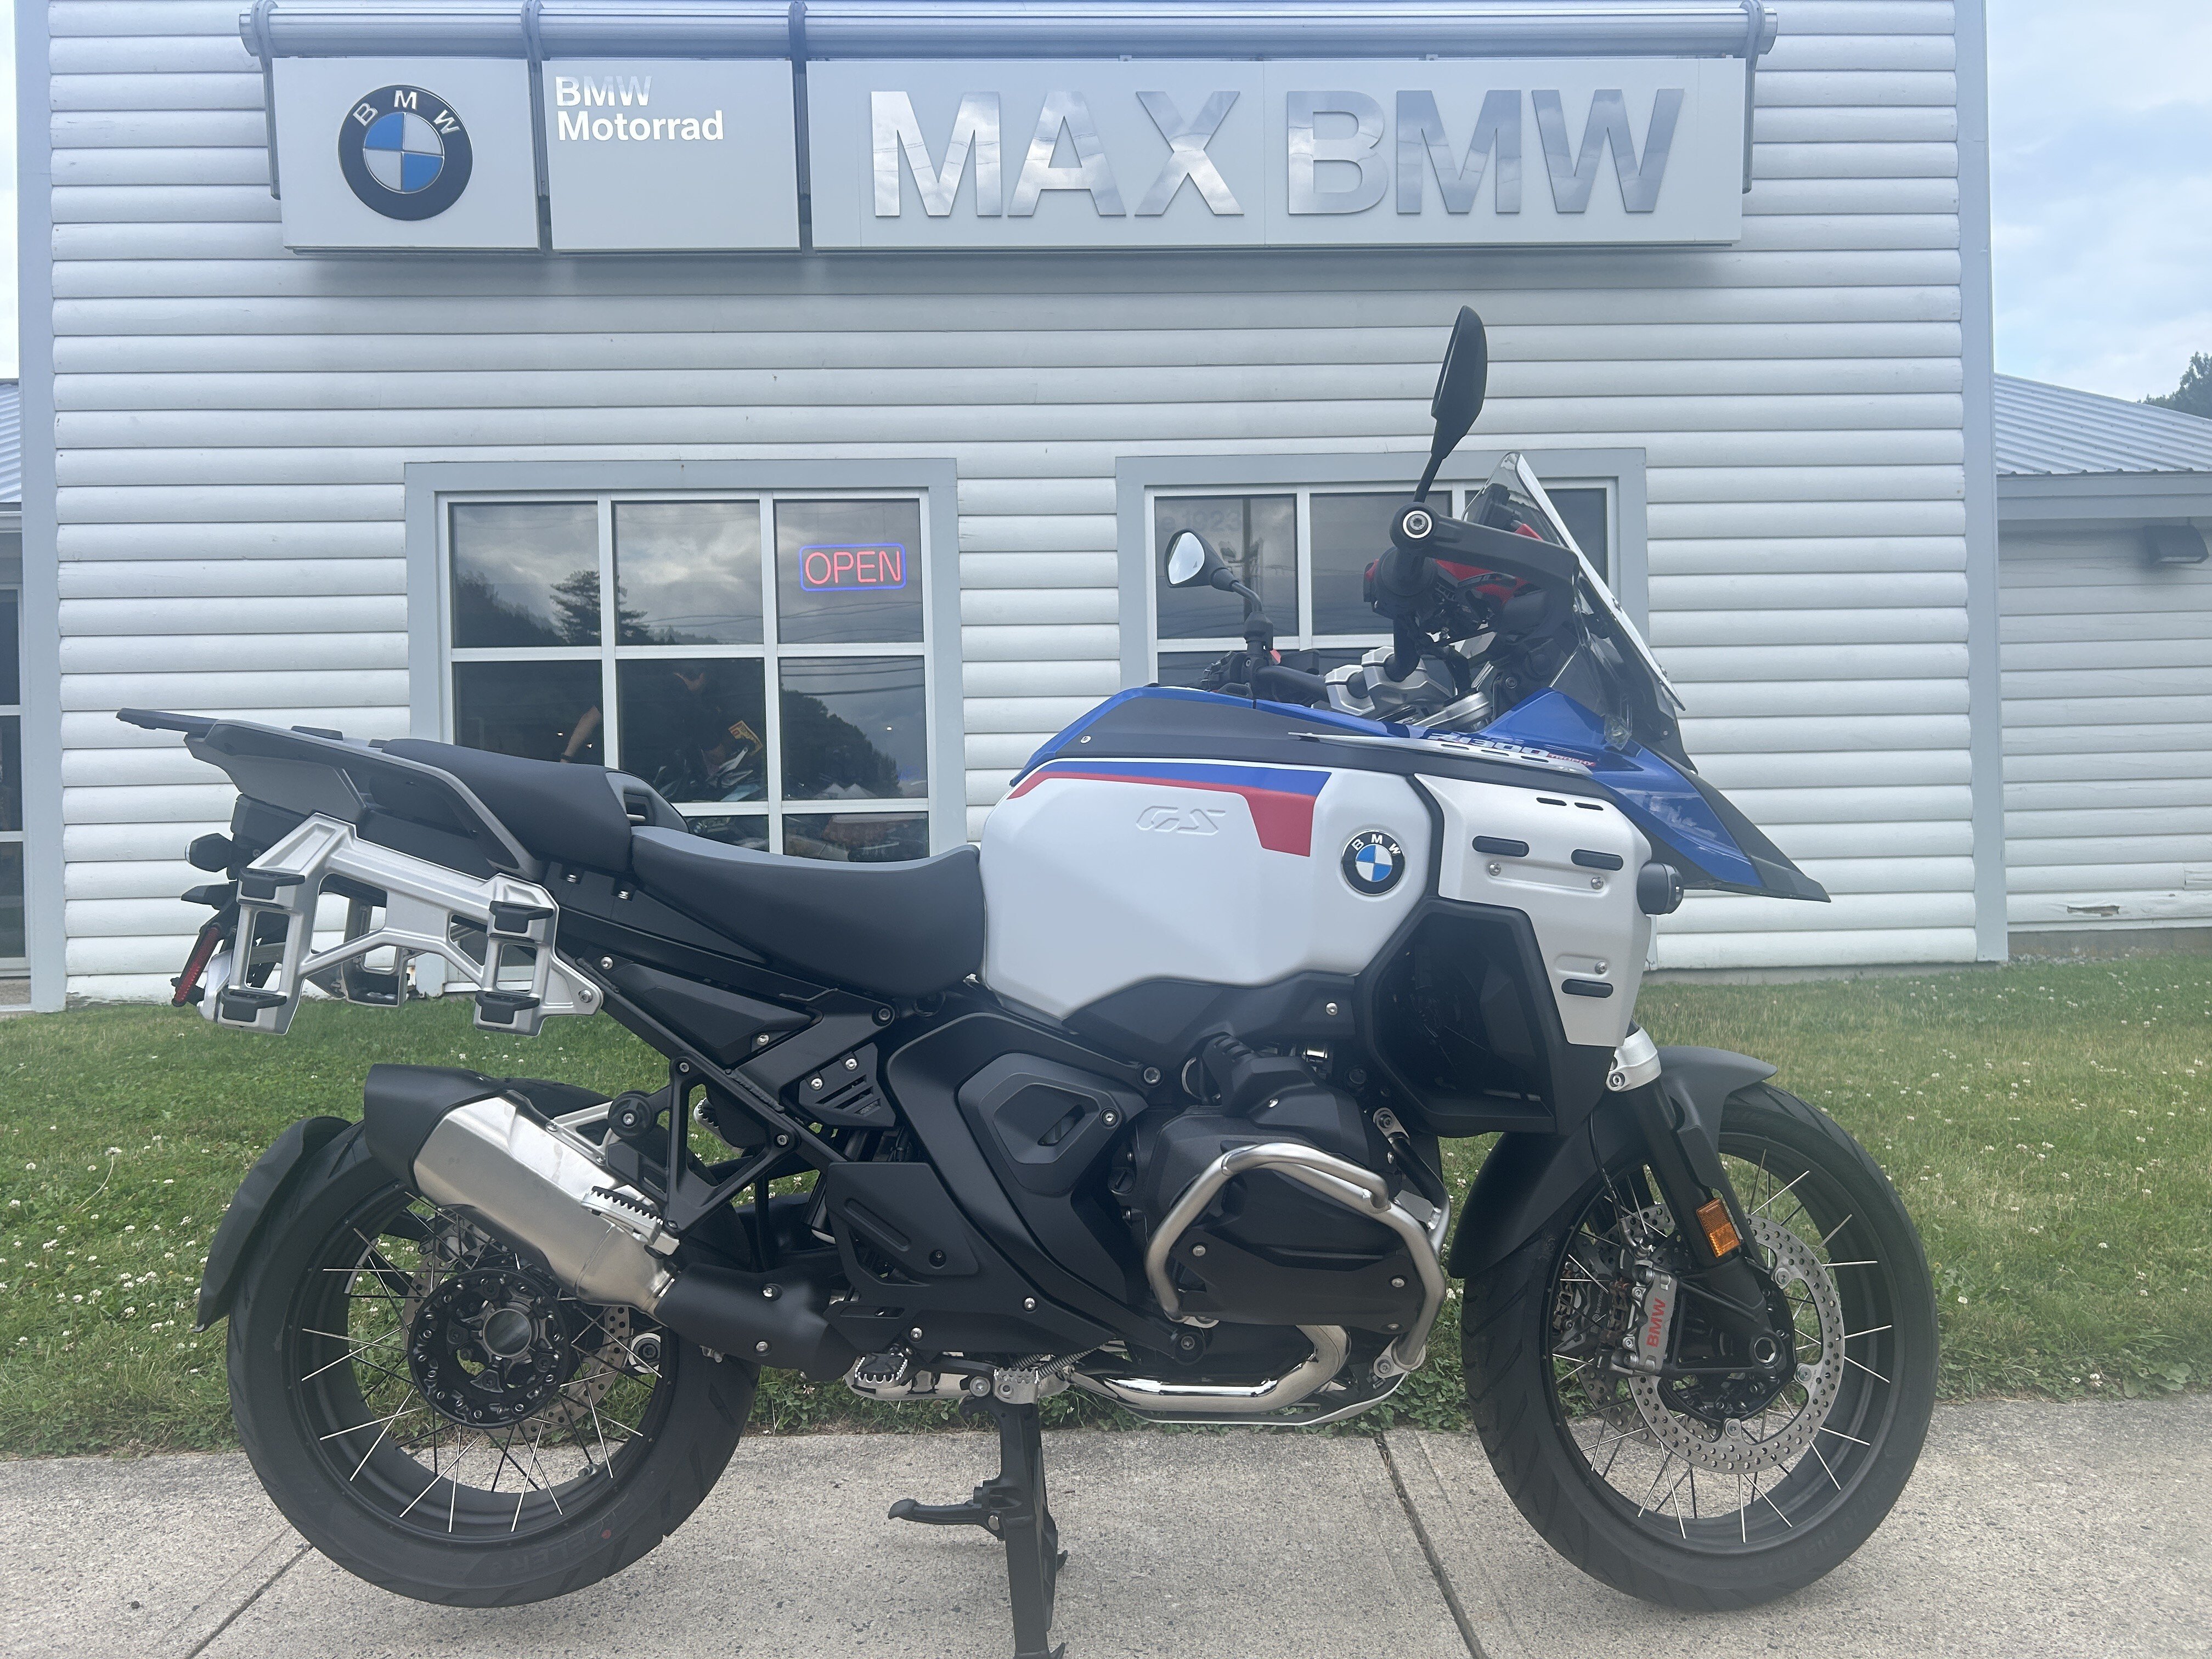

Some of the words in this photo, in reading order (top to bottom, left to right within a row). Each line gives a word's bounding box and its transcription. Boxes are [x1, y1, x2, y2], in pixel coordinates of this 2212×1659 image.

[554, 75, 652, 107] BMW
[352, 89, 461, 136] BMW
[557, 110, 724, 142] Motorrad
[869, 89, 1245, 219] MAX
[1286, 87, 1685, 216] BMW
[804, 550, 901, 585] OPEN
[1136, 805, 1226, 836] GS
[1351, 833, 1401, 856] BMW
[1646, 1297, 1666, 1347] BMW
